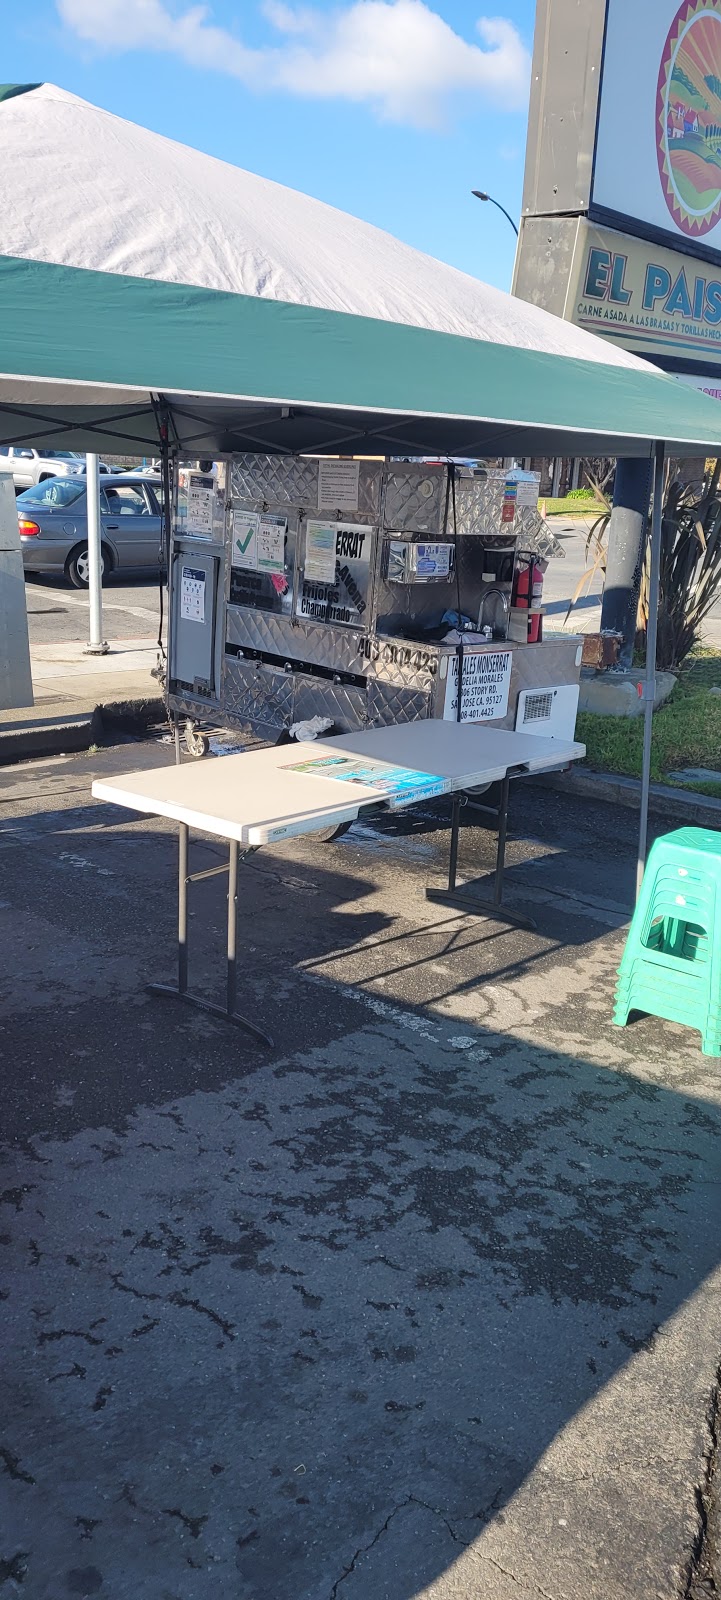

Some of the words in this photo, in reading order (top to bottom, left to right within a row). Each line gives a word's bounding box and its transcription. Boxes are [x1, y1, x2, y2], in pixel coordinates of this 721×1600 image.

[582, 246, 633, 306] EL
[577, 303, 602, 318] CARNE
[604, 309, 628, 323] ASADA
[629, 315, 635, 324] A
[635, 315, 649, 327] LAS
[650, 318, 674, 332] BRASAS
[675, 323, 681, 332] Y
[336, 530, 365, 559] ERRAT
[302, 584, 340, 604] Frijoles
[451, 656, 477, 676] TAALES
[477, 653, 510, 674] MONSERRAT
[454, 675, 478, 687] GDELIA
[478, 673, 504, 685] MORALES
[470, 685, 488, 696] STORY
[488, 684, 498, 694] RD.
[462, 697, 476, 708] JOSE
[485, 694, 503, 705] 95127
[458, 707, 495, 720] 08-401.4425
